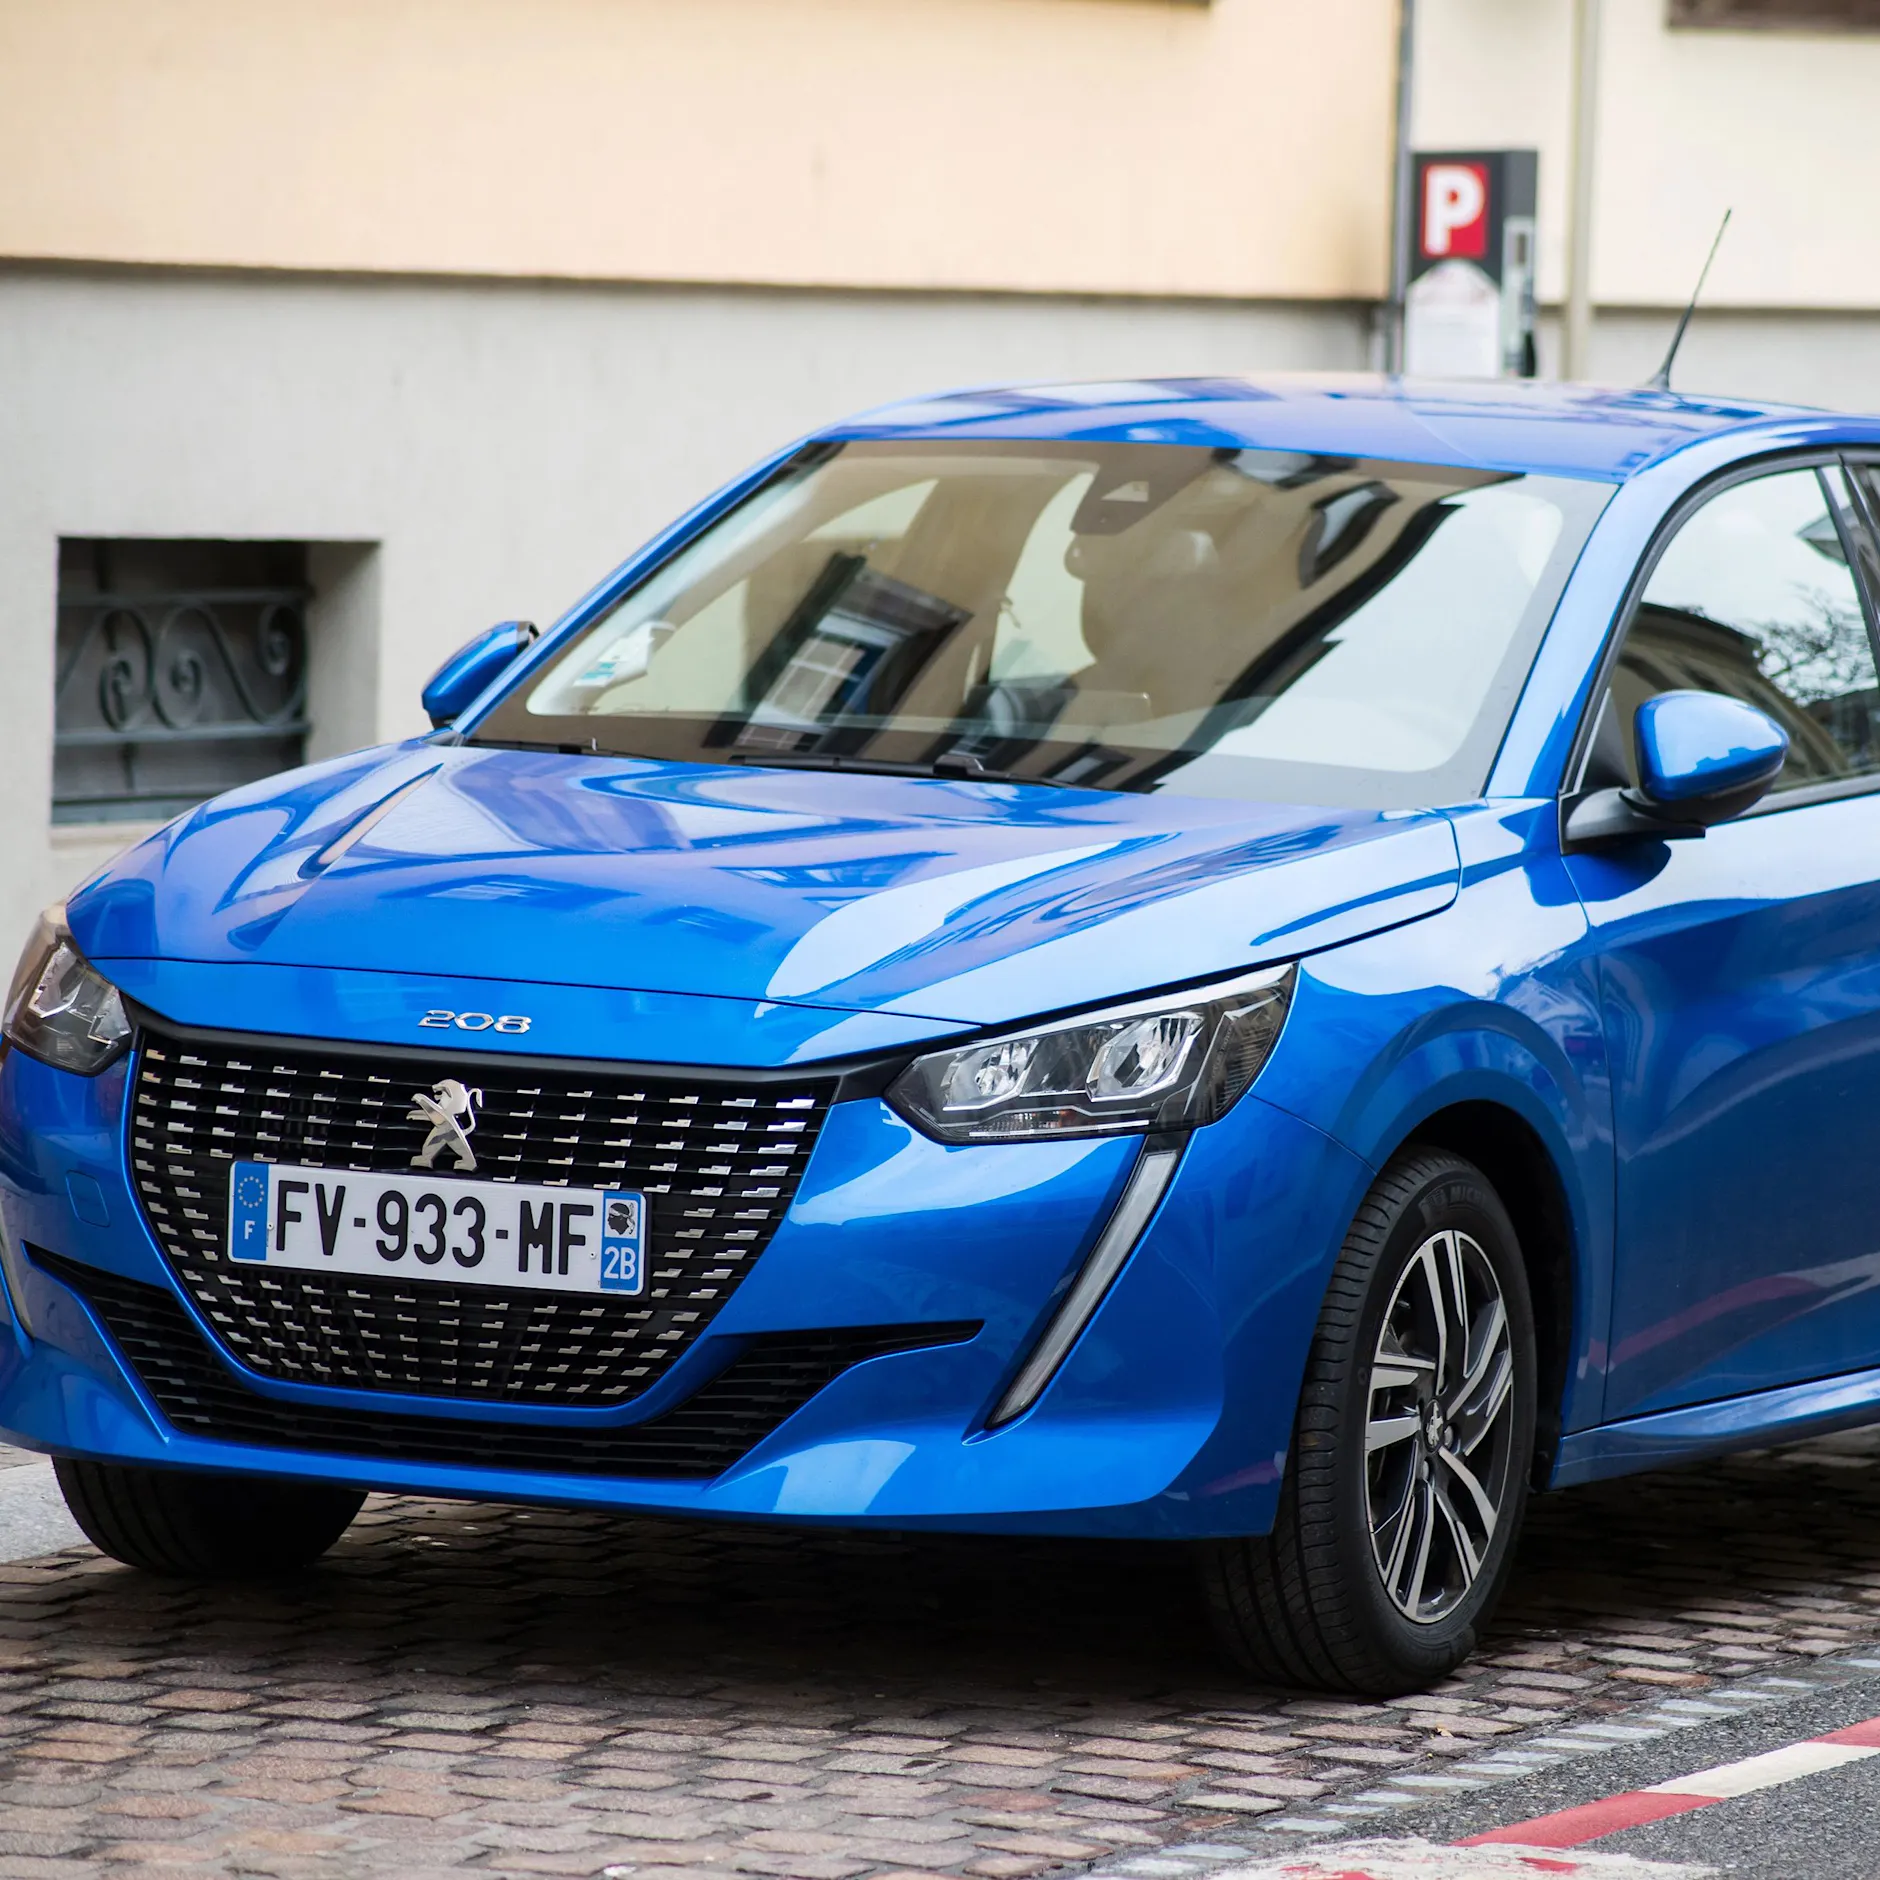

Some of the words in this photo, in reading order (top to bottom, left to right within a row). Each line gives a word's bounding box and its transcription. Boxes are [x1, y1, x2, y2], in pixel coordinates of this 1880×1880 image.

[1425, 165, 1484, 254] P
[418, 1009, 532, 1034] 208
[244, 1219, 256, 1240] F
[276, 1179, 594, 1275] FV-933-MF
[603, 1246, 636, 1280] 2B
